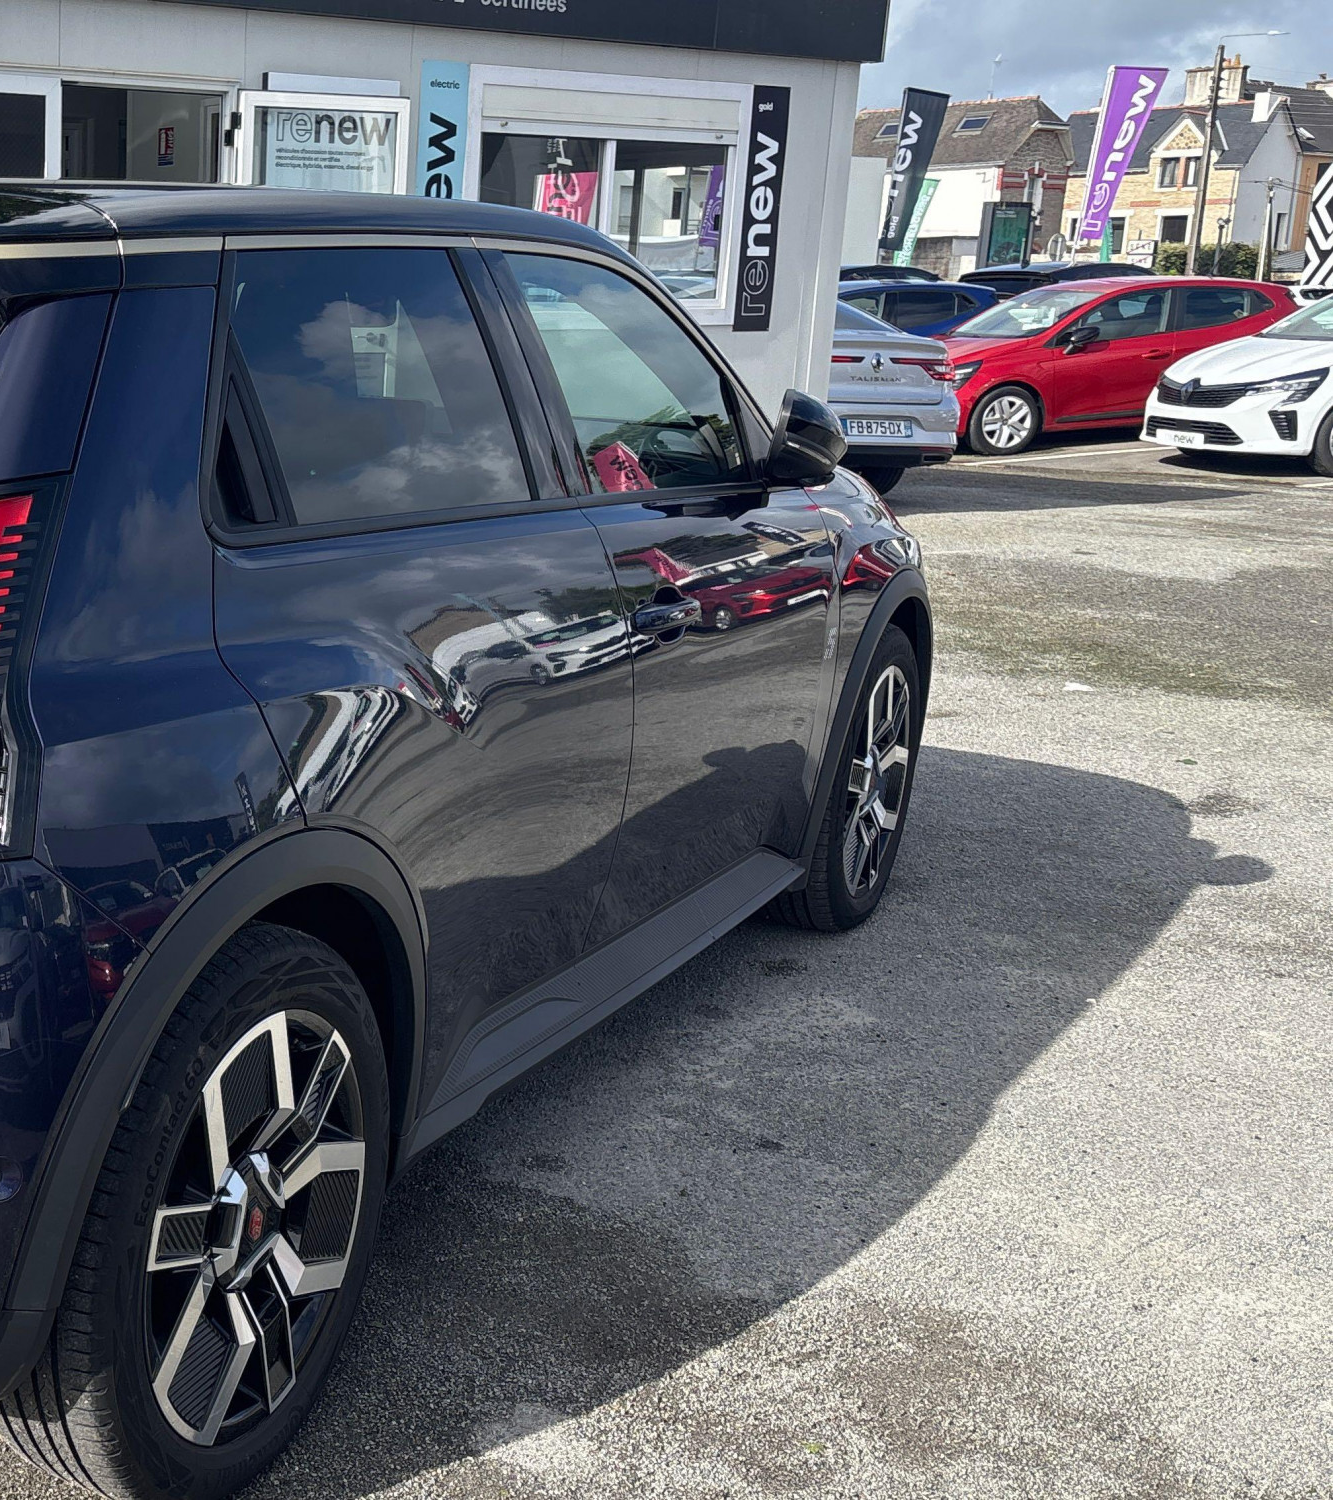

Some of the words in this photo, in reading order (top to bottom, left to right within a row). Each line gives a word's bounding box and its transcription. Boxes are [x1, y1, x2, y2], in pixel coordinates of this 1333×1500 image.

[430, 79, 460, 90] electric
[758, 102, 774, 112] gold
[275, 112, 392, 146] renew
[741, 131, 779, 316] renew
[887, 215, 899, 239] gold
[850, 375, 902, 383] TALISMAN
[134, 1090, 186, 1228] EcoContact
